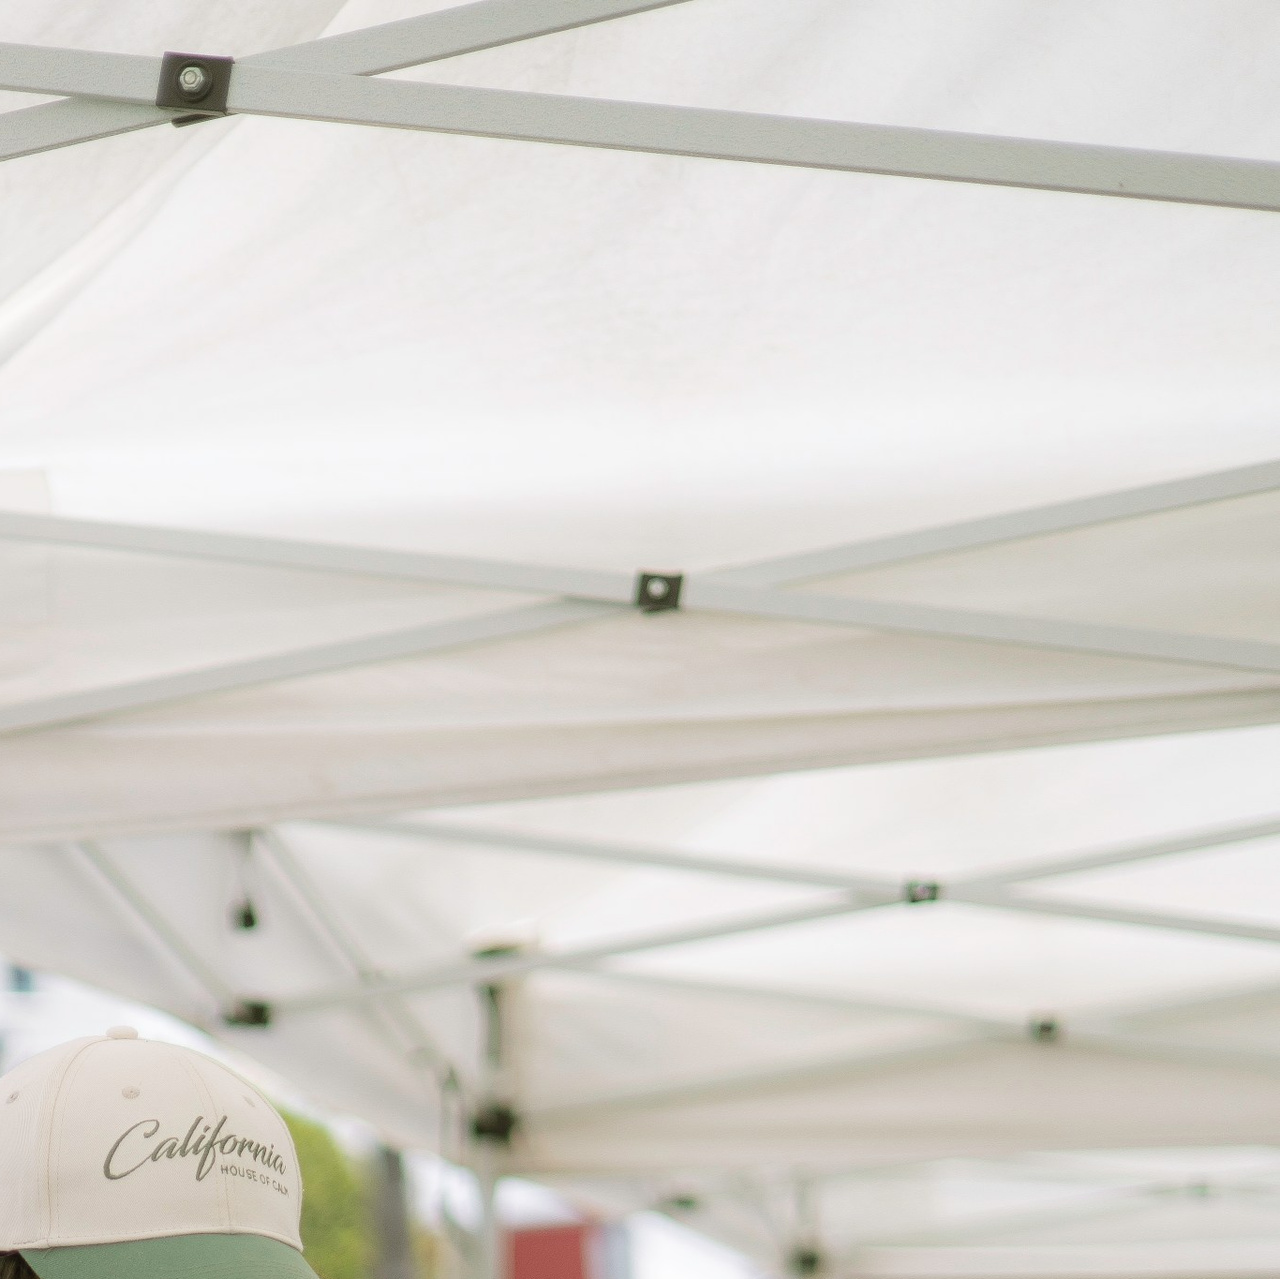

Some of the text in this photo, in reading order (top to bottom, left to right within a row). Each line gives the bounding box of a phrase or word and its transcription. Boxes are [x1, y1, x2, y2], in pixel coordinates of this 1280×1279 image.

[103, 1115, 287, 1182] California
[220, 1164, 258, 1182] HOUSE
[259, 1173, 271, 1186] OF
